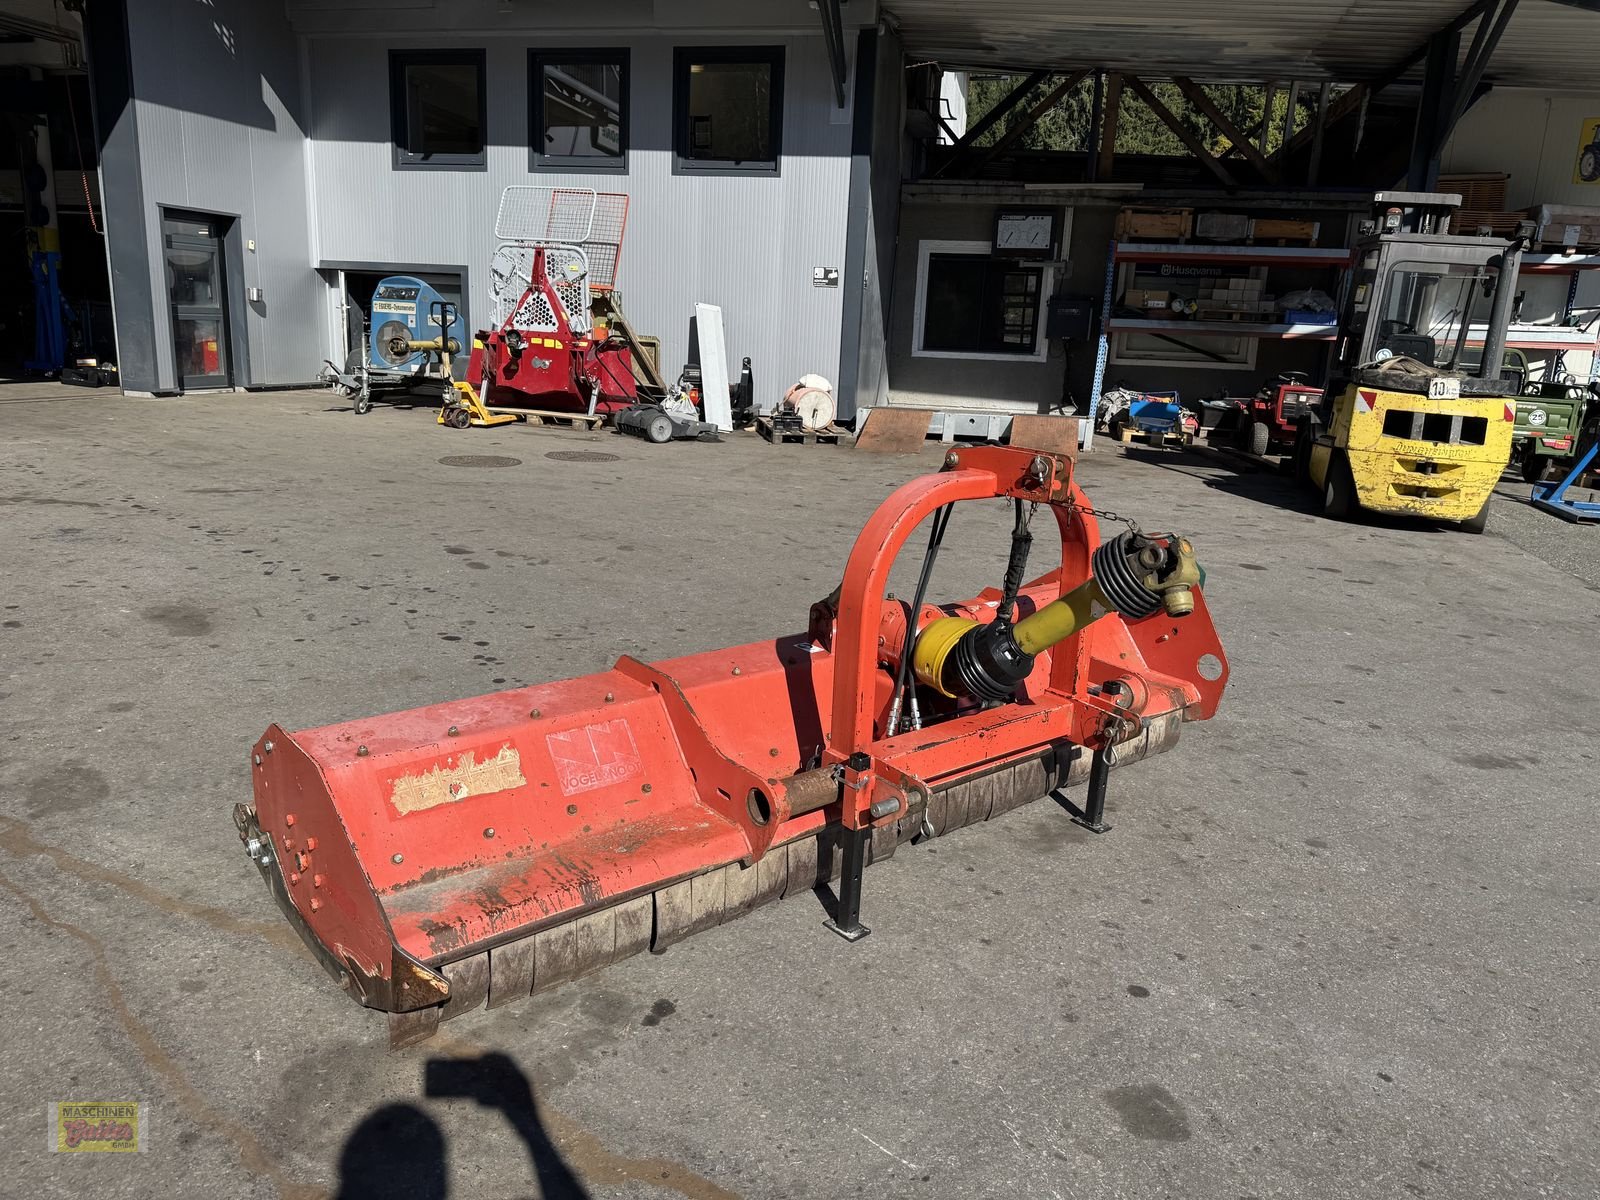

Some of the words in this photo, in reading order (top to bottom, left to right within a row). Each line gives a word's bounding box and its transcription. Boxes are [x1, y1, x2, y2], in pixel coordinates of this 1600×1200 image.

[1172, 265, 1222, 277] Husqvarna
[1432, 381, 1445, 396] 10
[1532, 413, 1543, 421] 25
[561, 772, 602, 789] VOGEL
[608, 761, 641, 779] NOOT
